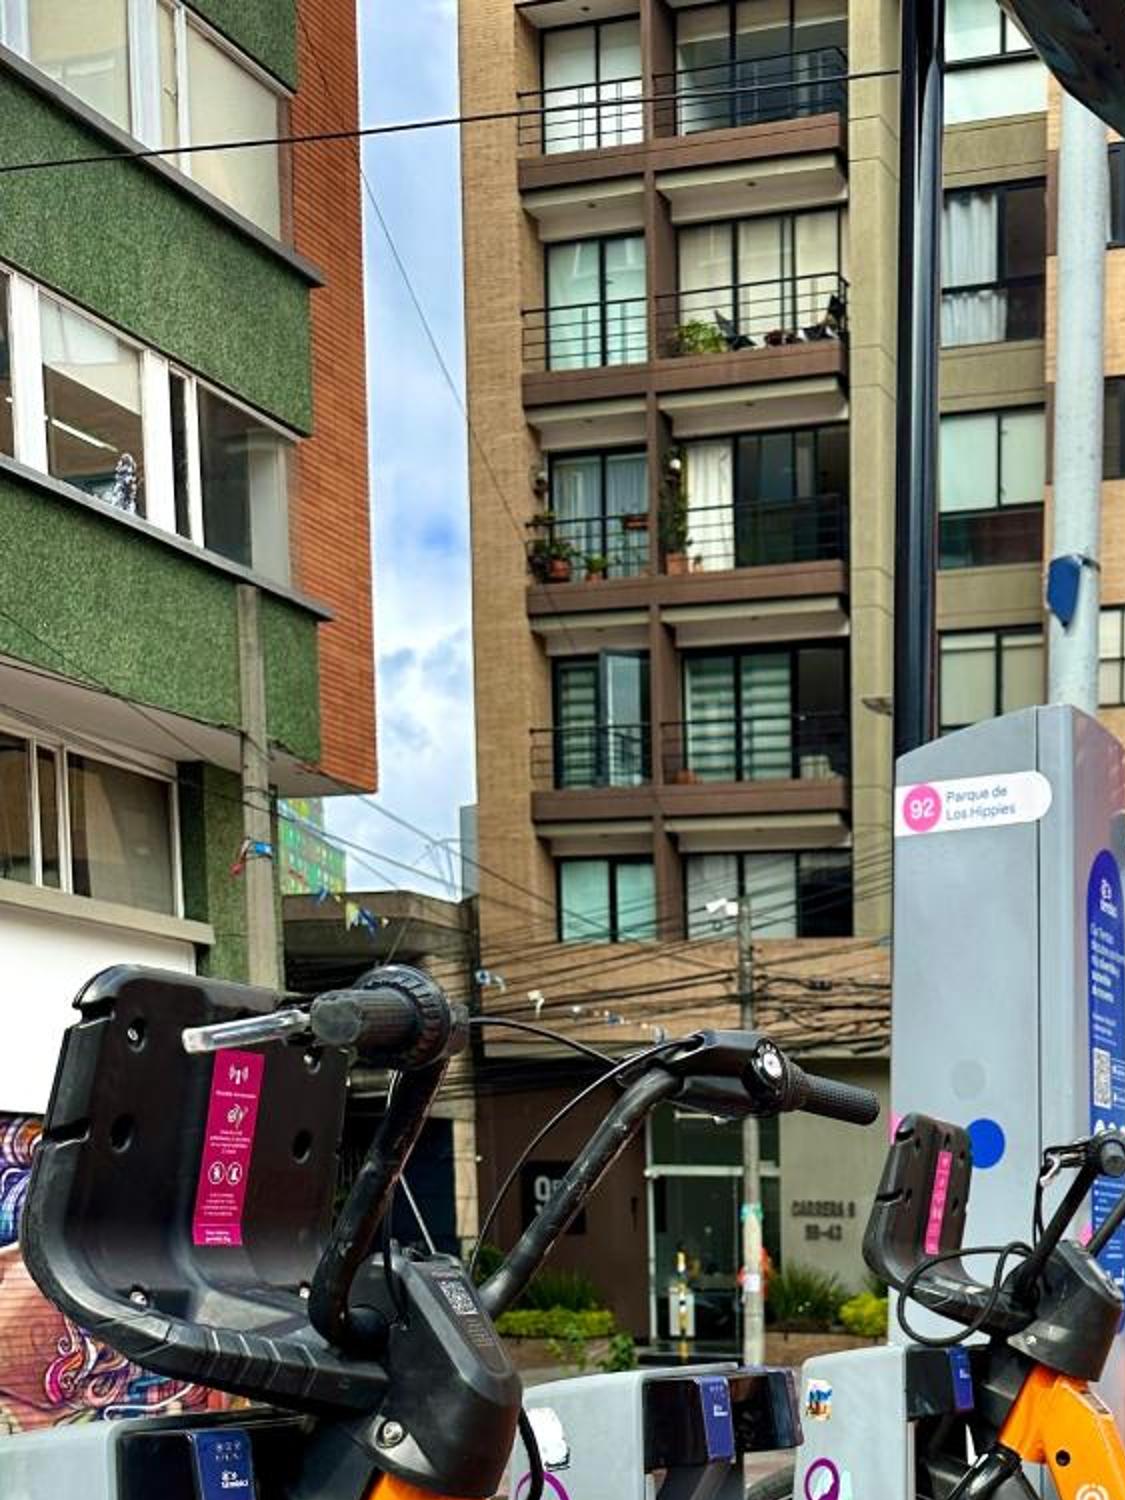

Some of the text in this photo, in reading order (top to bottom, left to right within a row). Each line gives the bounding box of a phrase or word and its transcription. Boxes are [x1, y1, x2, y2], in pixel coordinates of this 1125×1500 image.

[946, 785, 1008, 804] Parque de
[909, 797, 936, 820] 92
[946, 803, 1016, 821] Los Hippies
